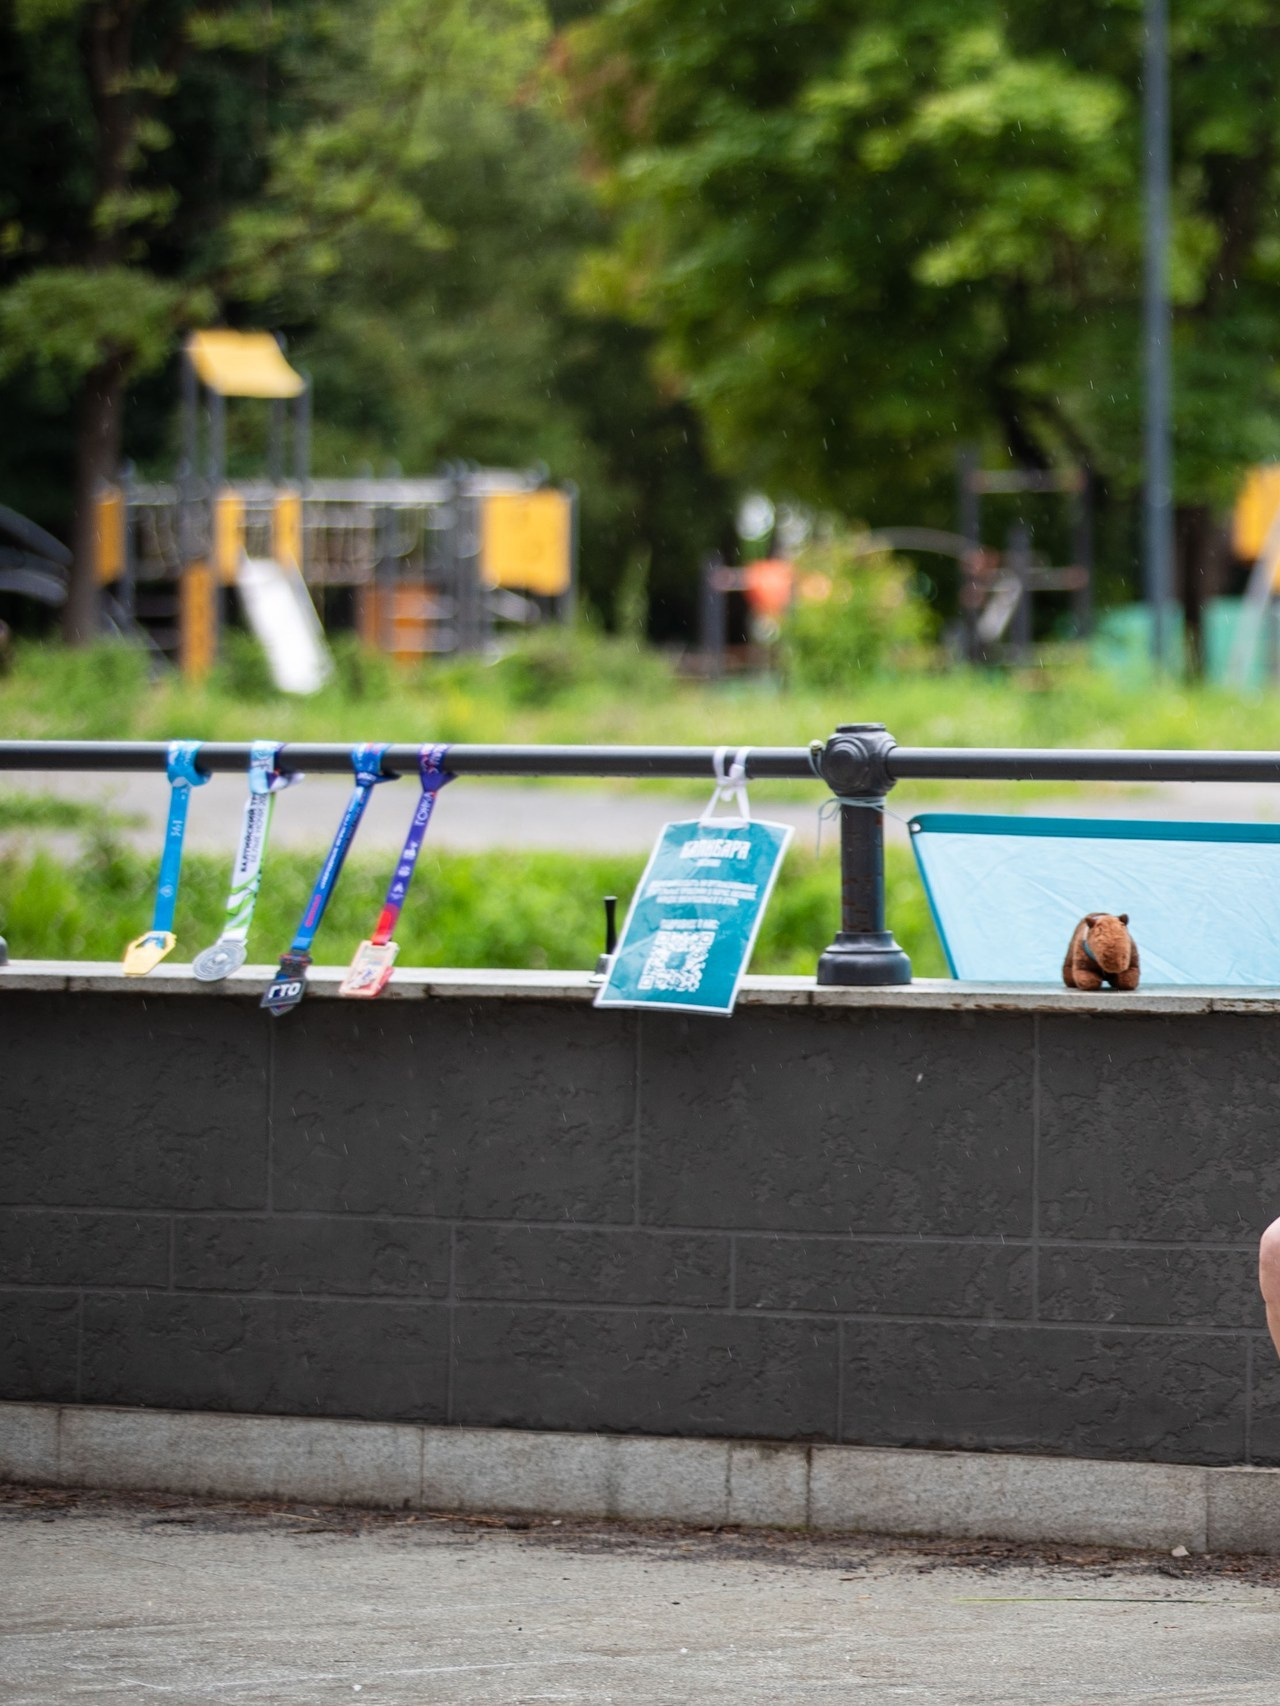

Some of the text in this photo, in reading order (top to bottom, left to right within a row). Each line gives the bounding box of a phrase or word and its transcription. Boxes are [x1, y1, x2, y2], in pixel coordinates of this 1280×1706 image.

[415, 791, 437, 826] ГОНКА
[240, 809, 256, 872] БАЛТИЙСКИЙ
[268, 982, 301, 999] ГТО
